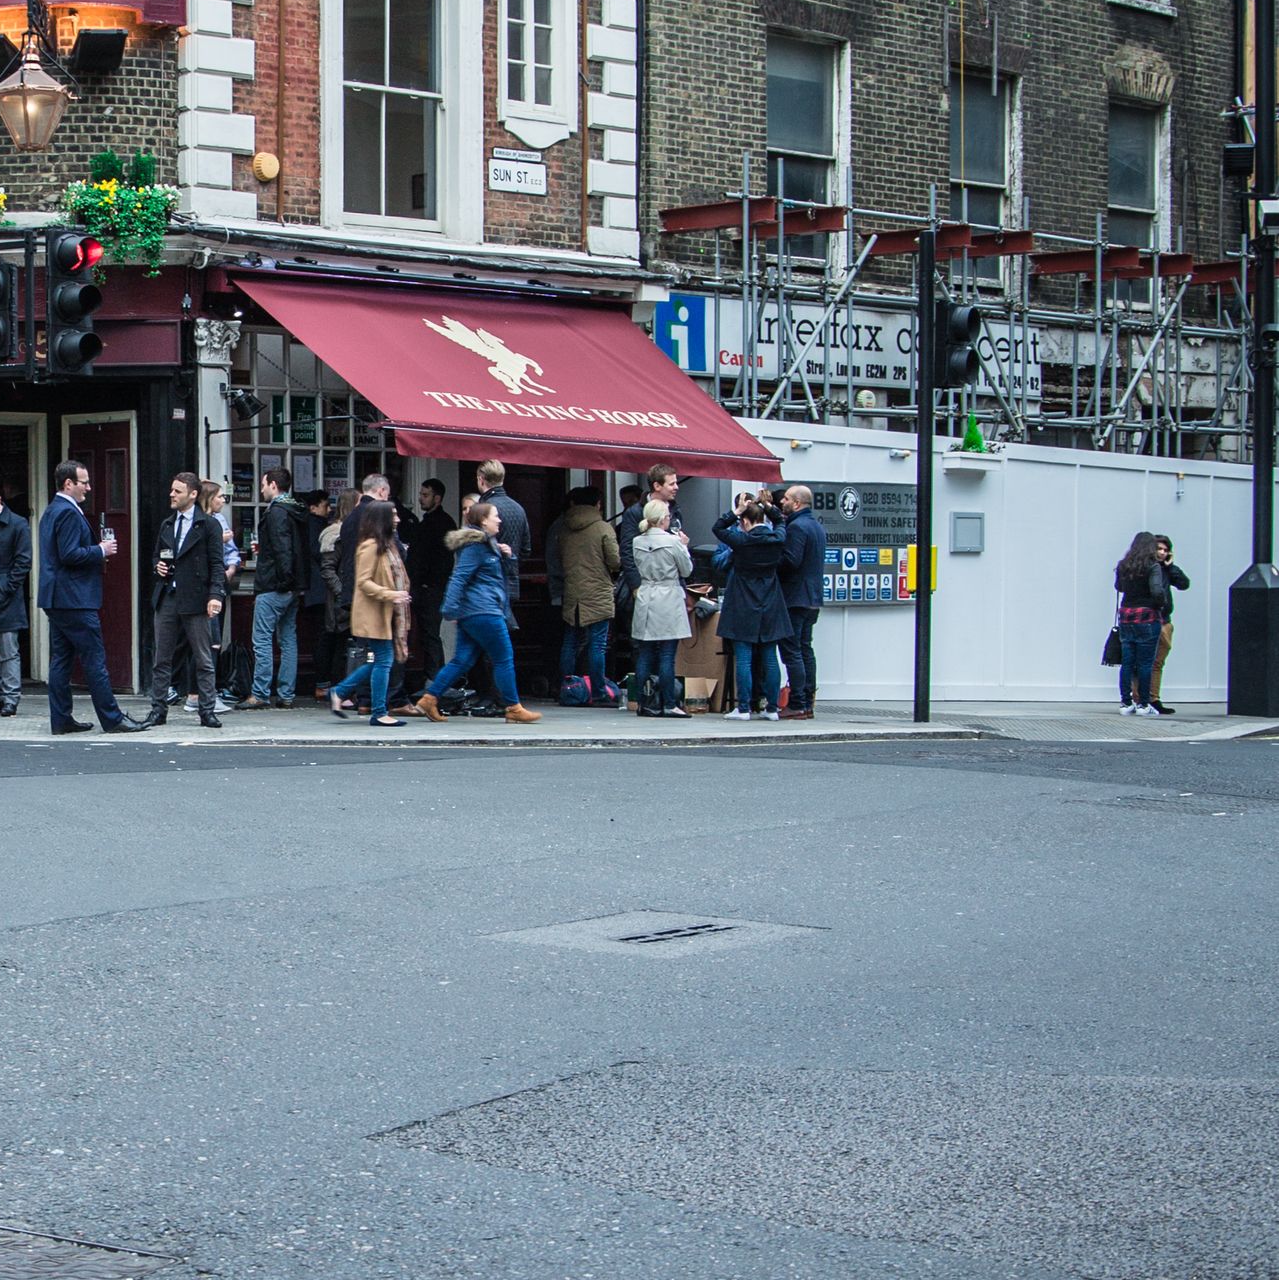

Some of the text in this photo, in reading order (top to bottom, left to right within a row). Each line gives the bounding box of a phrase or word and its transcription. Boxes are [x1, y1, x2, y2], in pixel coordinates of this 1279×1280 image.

[493, 168, 512, 182] SUN
[757, 309, 883, 352] inerfax
[836, 361, 860, 377] Lonon
[866, 364, 887, 379] EC2M
[423, 391, 688, 429] THE FLYING HORSE
[294, 430, 314, 440] point
[862, 493, 878, 505] 020
[862, 516, 917, 528] THINK SAFET
[863, 533, 890, 545] PROTECT
[893, 534, 917, 545] YOURSE
